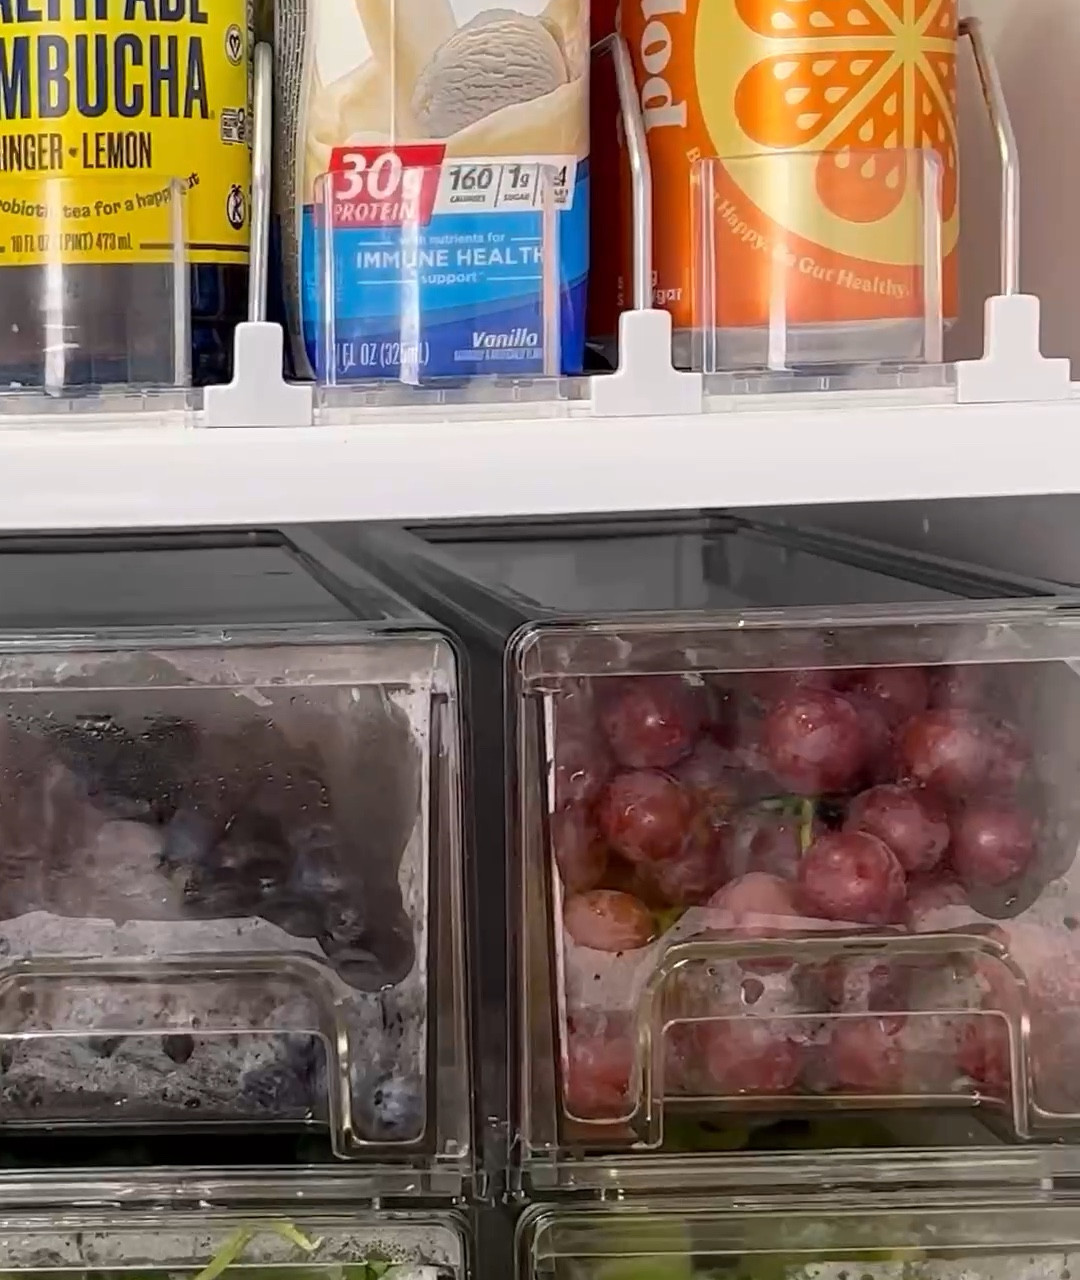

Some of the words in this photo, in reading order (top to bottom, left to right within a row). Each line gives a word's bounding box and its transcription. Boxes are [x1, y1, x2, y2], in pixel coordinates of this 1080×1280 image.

[82, 130, 152, 170] LEMON
[449, 165, 494, 191] 160
[508, 165, 530, 189] 1g
[62, 204, 91, 219] tea
[94, 200, 122, 217] for
[124, 199, 135, 211] a
[335, 201, 417, 222] PROTEIN
[95, 231, 117, 252] 473
[487, 232, 505, 244] for
[356, 249, 450, 270] IMMUNE
[799, 256, 834, 282] Gut
[472, 327, 539, 349] Vanilla
[360, 342, 378, 366] OZ
